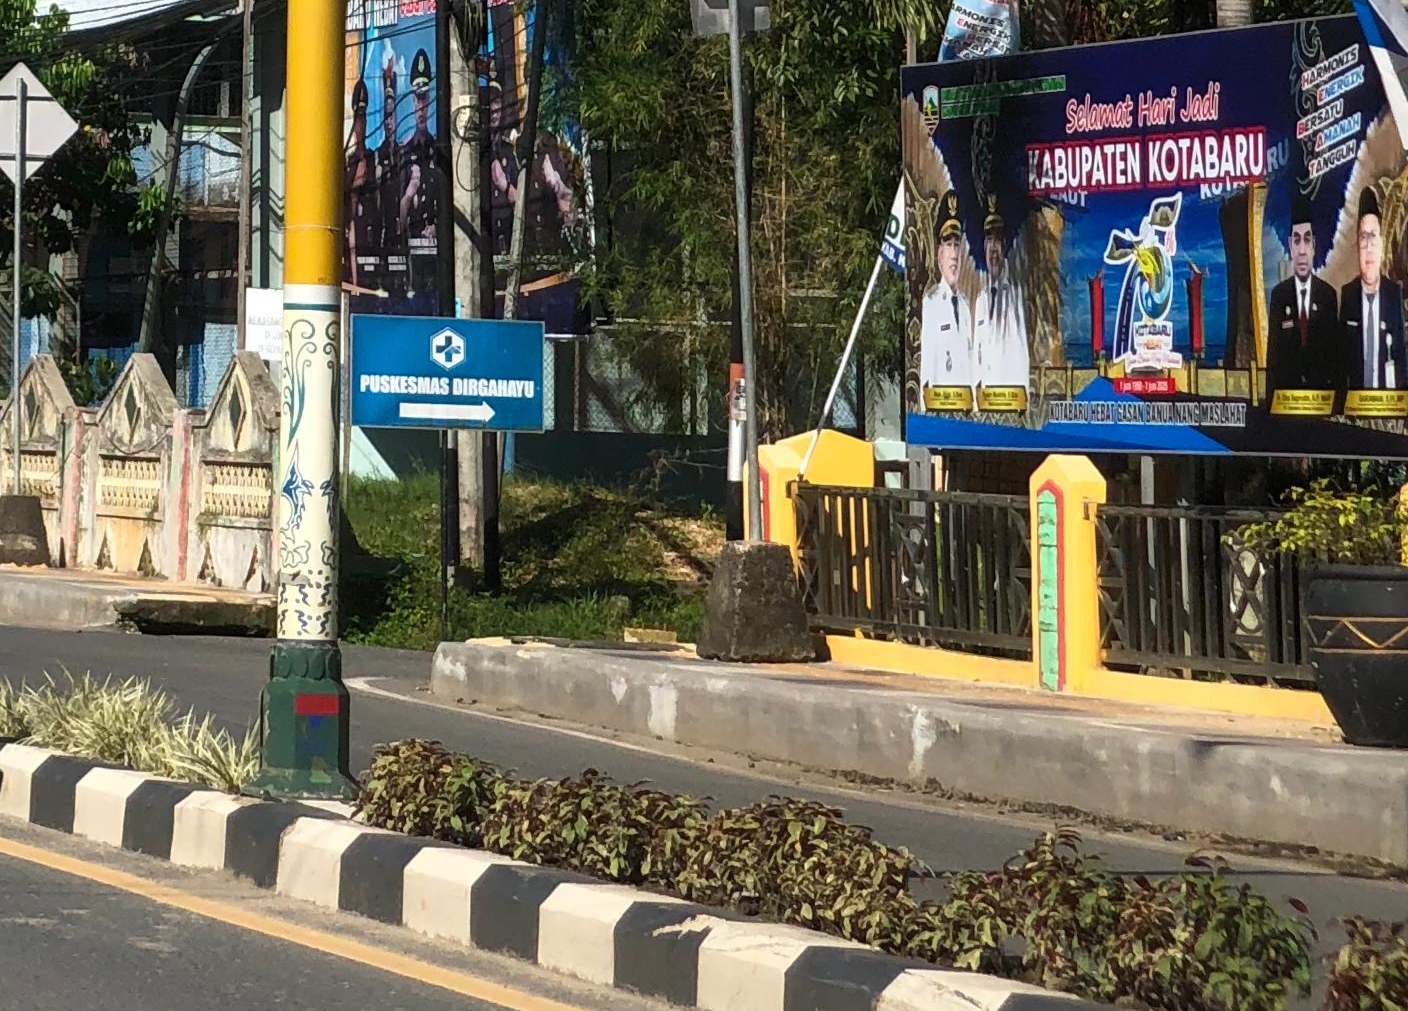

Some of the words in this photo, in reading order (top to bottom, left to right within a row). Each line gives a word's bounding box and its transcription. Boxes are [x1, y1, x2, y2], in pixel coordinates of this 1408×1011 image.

[1302, 46, 1358, 90] HARMONIS
[1318, 66, 1364, 104] ENERGIK
[1066, 93, 1134, 134] Selamat
[1138, 86, 1178, 127] Hari
[1180, 81, 1221, 123] Jadi
[1297, 100, 1343, 138] BERSATU
[1315, 113, 1361, 151] AMANAH
[1028, 142, 1141, 190] KABUPATEN
[1148, 132, 1264, 184] KOTABARU
[1309, 140, 1356, 178] TANGGUH
[360, 374, 449, 395] PUSKESMAS
[452, 378, 535, 399] DIRGAHAYU
[1050, 401, 1089, 423] KOTABARU
[1091, 401, 1115, 424] HEBAT
[1117, 401, 1144, 424] GASAN
[1145, 401, 1175, 426] BANUA
[1176, 402, 1200, 426] NANG
[1200, 402, 1247, 427] MASLAHAT
